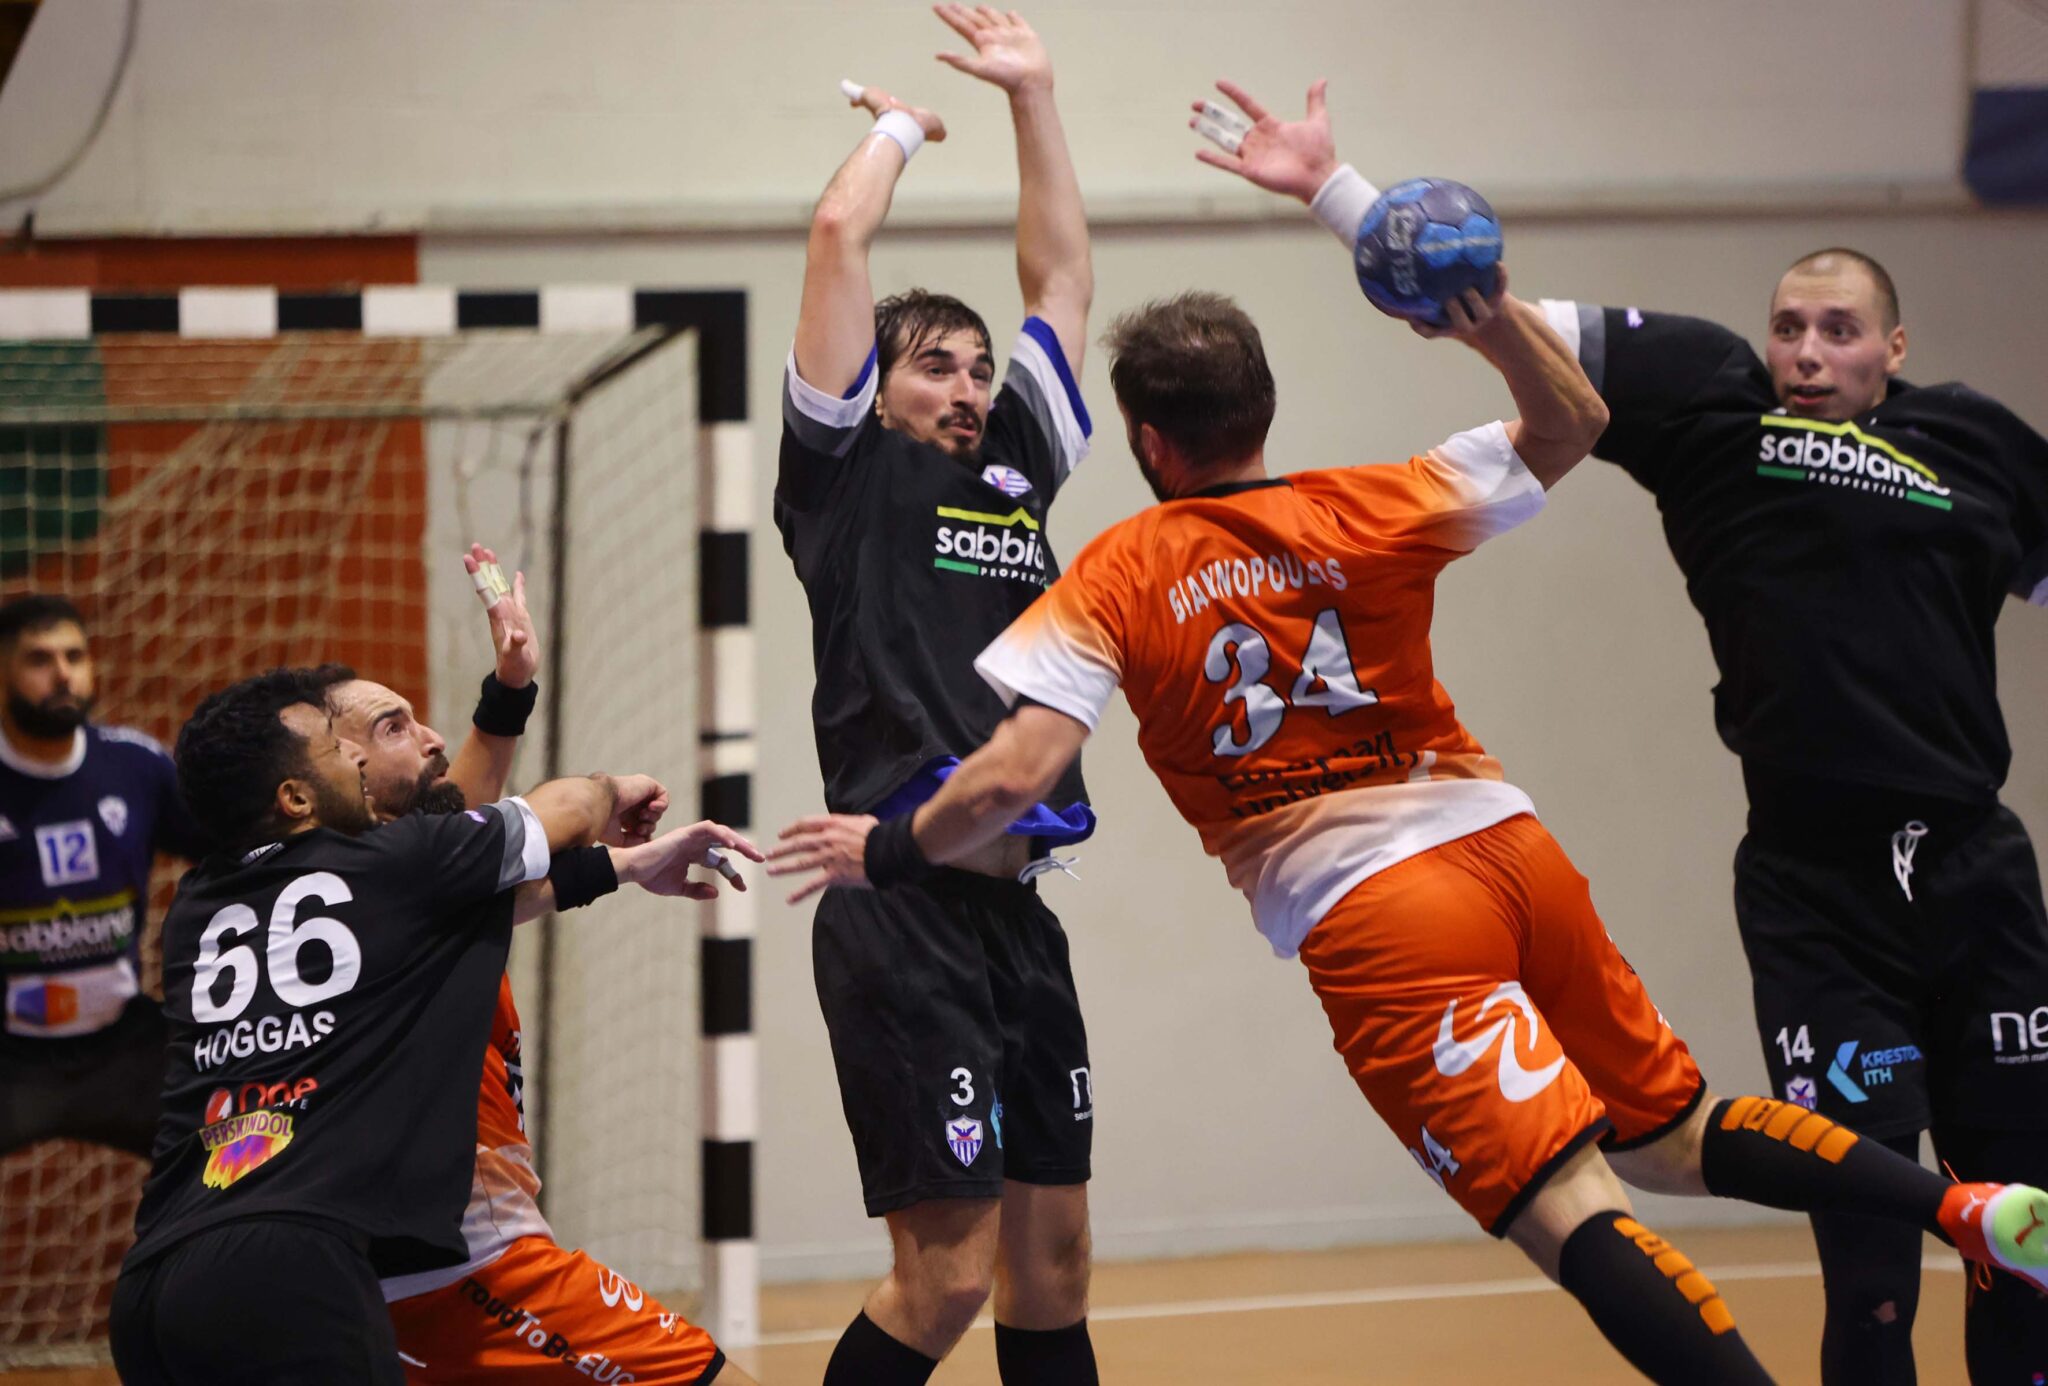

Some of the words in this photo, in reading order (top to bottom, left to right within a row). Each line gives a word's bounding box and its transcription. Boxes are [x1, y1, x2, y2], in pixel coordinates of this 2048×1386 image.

[980, 566, 1047, 587] PROPER
[1205, 608, 1380, 756] 34
[44, 833, 91, 877] 12
[191, 871, 362, 1023] 66
[194, 1011, 337, 1072] HOGGAS
[1775, 1025, 1815, 1066] 14
[950, 1067, 975, 1106] 3
[1863, 1067, 1893, 1086] ITH
[202, 1114, 291, 1147] PERSKINDOL
